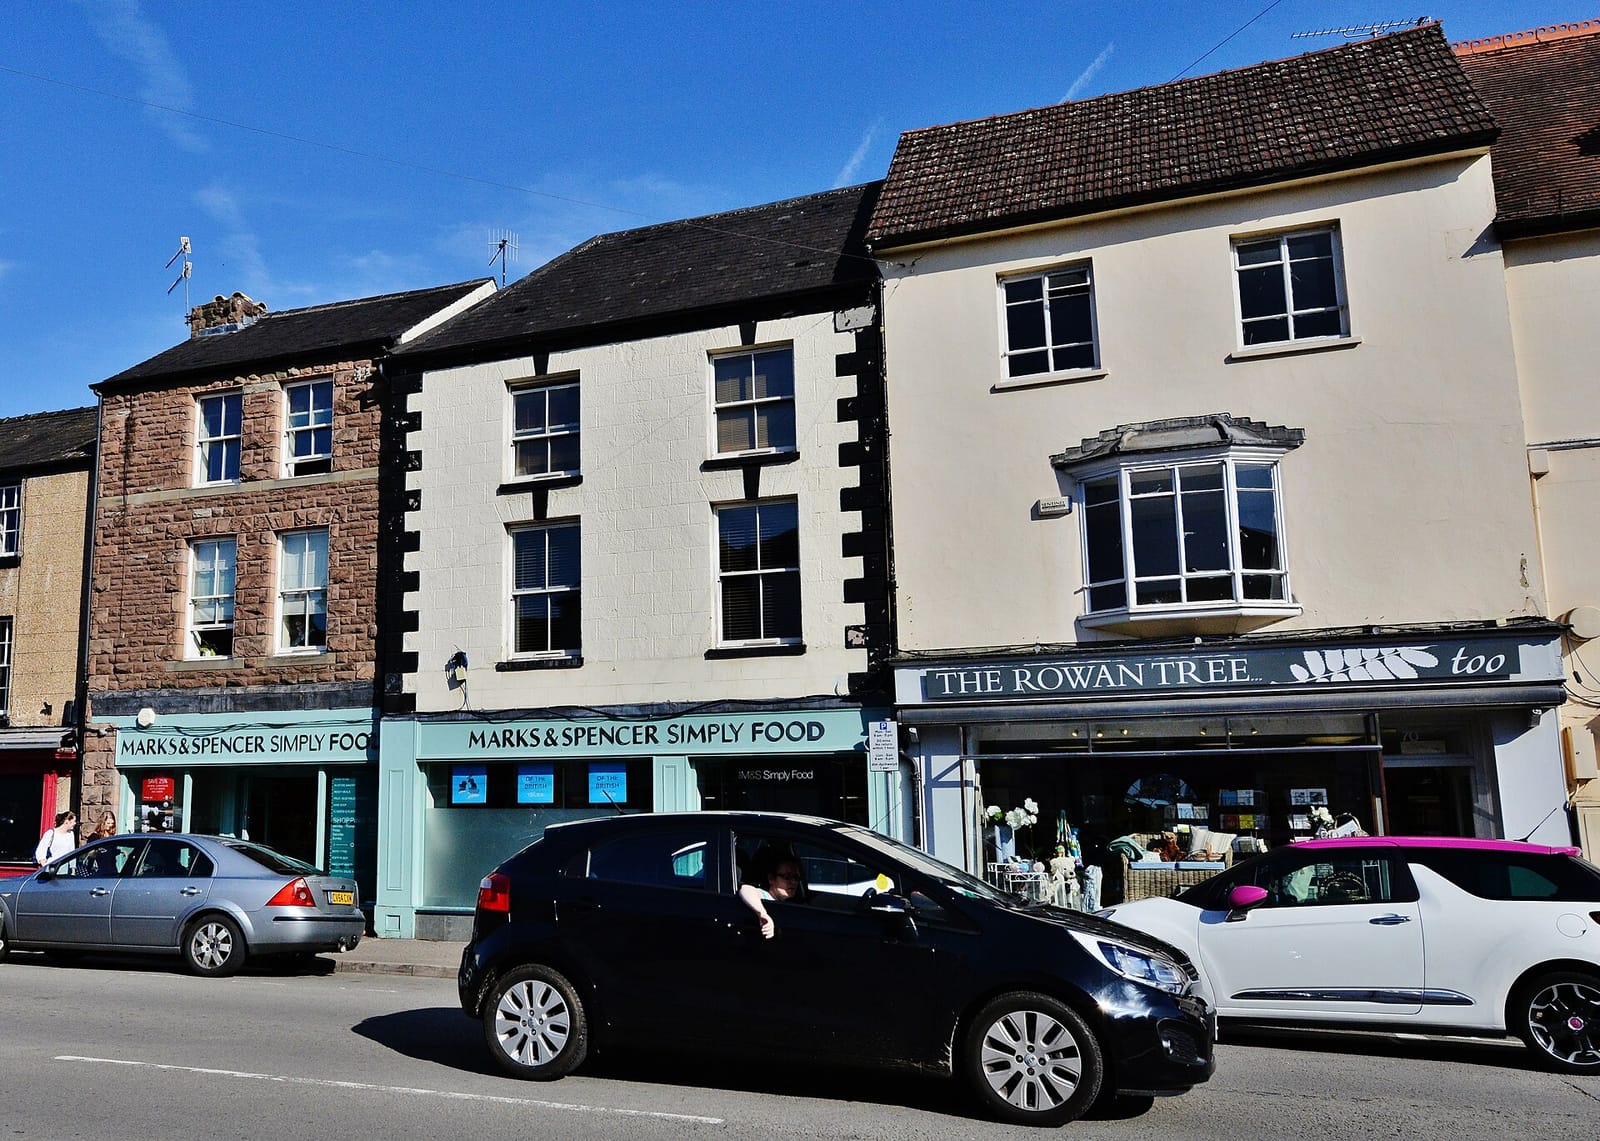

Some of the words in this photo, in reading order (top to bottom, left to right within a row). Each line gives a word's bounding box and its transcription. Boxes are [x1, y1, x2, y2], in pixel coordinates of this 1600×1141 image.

[1451, 647, 1506, 674] too
[936, 669, 1003, 694] THE
[1012, 662, 1145, 693] ROWAN
[270, 733, 325, 753] SIMPLY
[329, 732, 372, 751] FOO
[667, 722, 744, 745] SIMPLY
[751, 721, 825, 742] FOOD
[763, 769, 790, 781] Simply
[791, 769, 814, 780] Food
